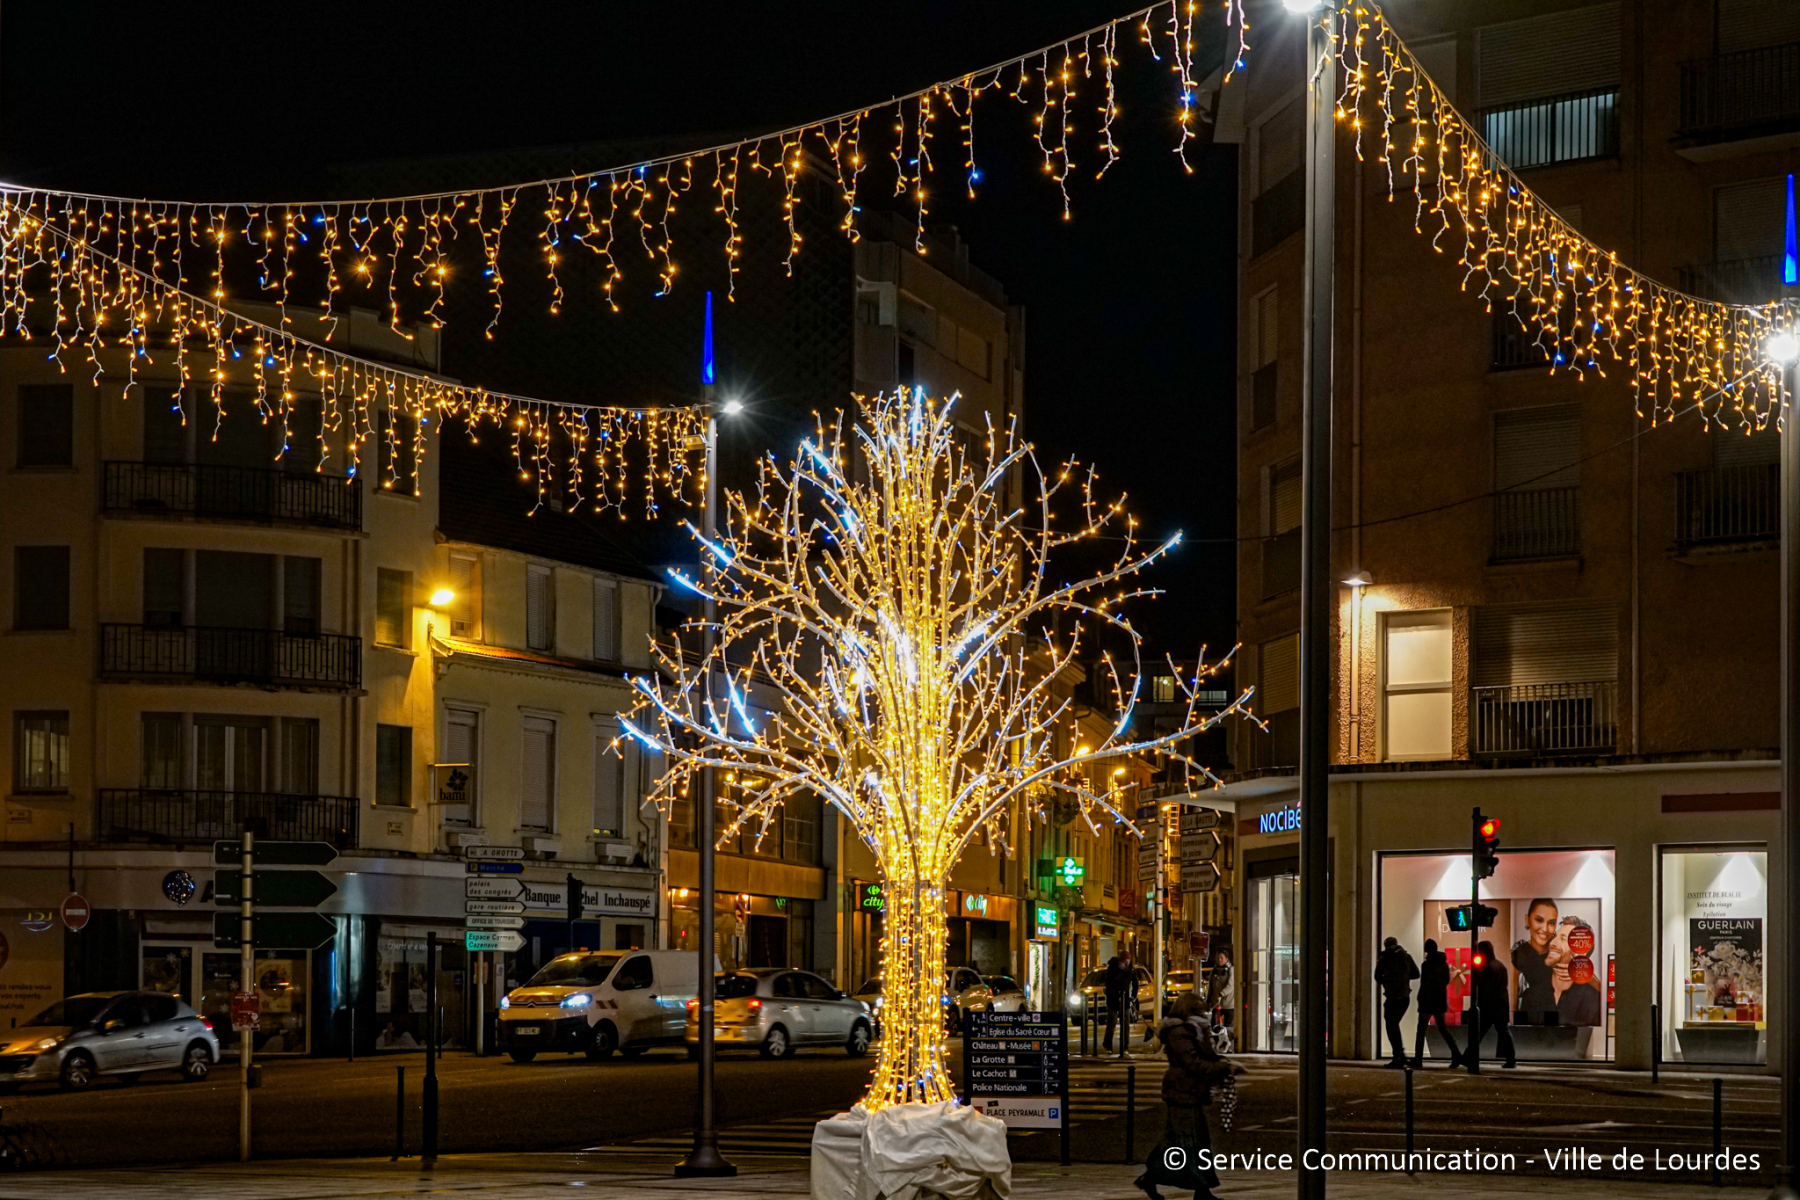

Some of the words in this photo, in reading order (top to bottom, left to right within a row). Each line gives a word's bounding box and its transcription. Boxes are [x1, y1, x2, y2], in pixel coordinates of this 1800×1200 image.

[440, 787, 465, 801] bami
[491, 849, 519, 857] GROTTE
[469, 880, 491, 888] palais
[1686, 891, 1712, 899] INSTITUT
[524, 888, 561, 907] Banque
[604, 892, 651, 912] Inchauspé
[863, 896, 885, 910] city
[1697, 920, 1755, 930] GUERLAIN
[468, 933, 490, 941] Espace
[1570, 939, 1592, 949] -40%
[989, 1013, 1031, 1022] Centre-ville
[989, 1028, 1006, 1037] Eglise
[1015, 1027, 1032, 1036] Sacré
[972, 1041, 999, 1050] Château
[972, 1055, 981, 1063] La
[981, 1055, 1006, 1064] Grotte
[972, 1069, 981, 1077] Le
[982, 1069, 1007, 1078] Cachot
[972, 1083, 993, 1092] Police
[993, 1083, 1028, 1092] Nationale
[986, 1108, 1006, 1117] PLACE
[1008, 1109, 1046, 1117] PEYRAMALE
